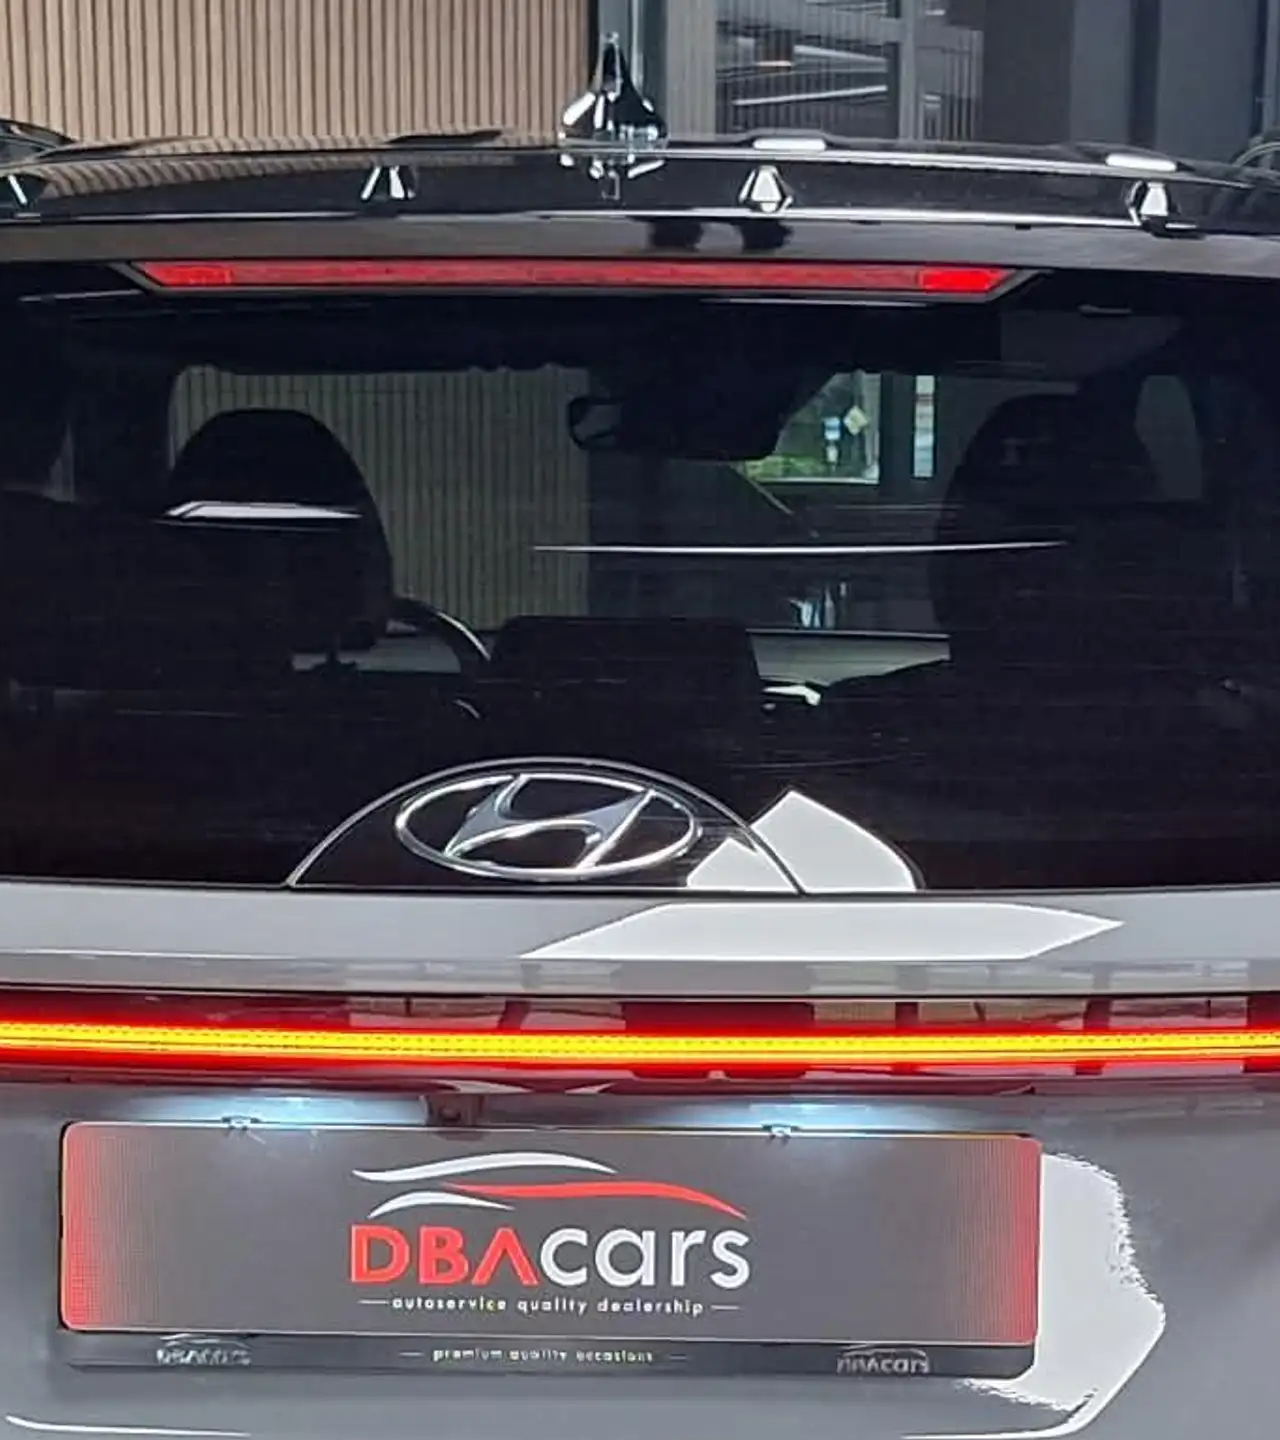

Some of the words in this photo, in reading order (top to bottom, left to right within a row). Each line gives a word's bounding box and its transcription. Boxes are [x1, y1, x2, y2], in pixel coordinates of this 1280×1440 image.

[350, 1224, 750, 1289] DBAcars
[391, 1296, 506, 1312] autoservice
[517, 1297, 588, 1316] quality
[596, 1297, 704, 1318] dealership
[432, 1348, 503, 1362] premium
